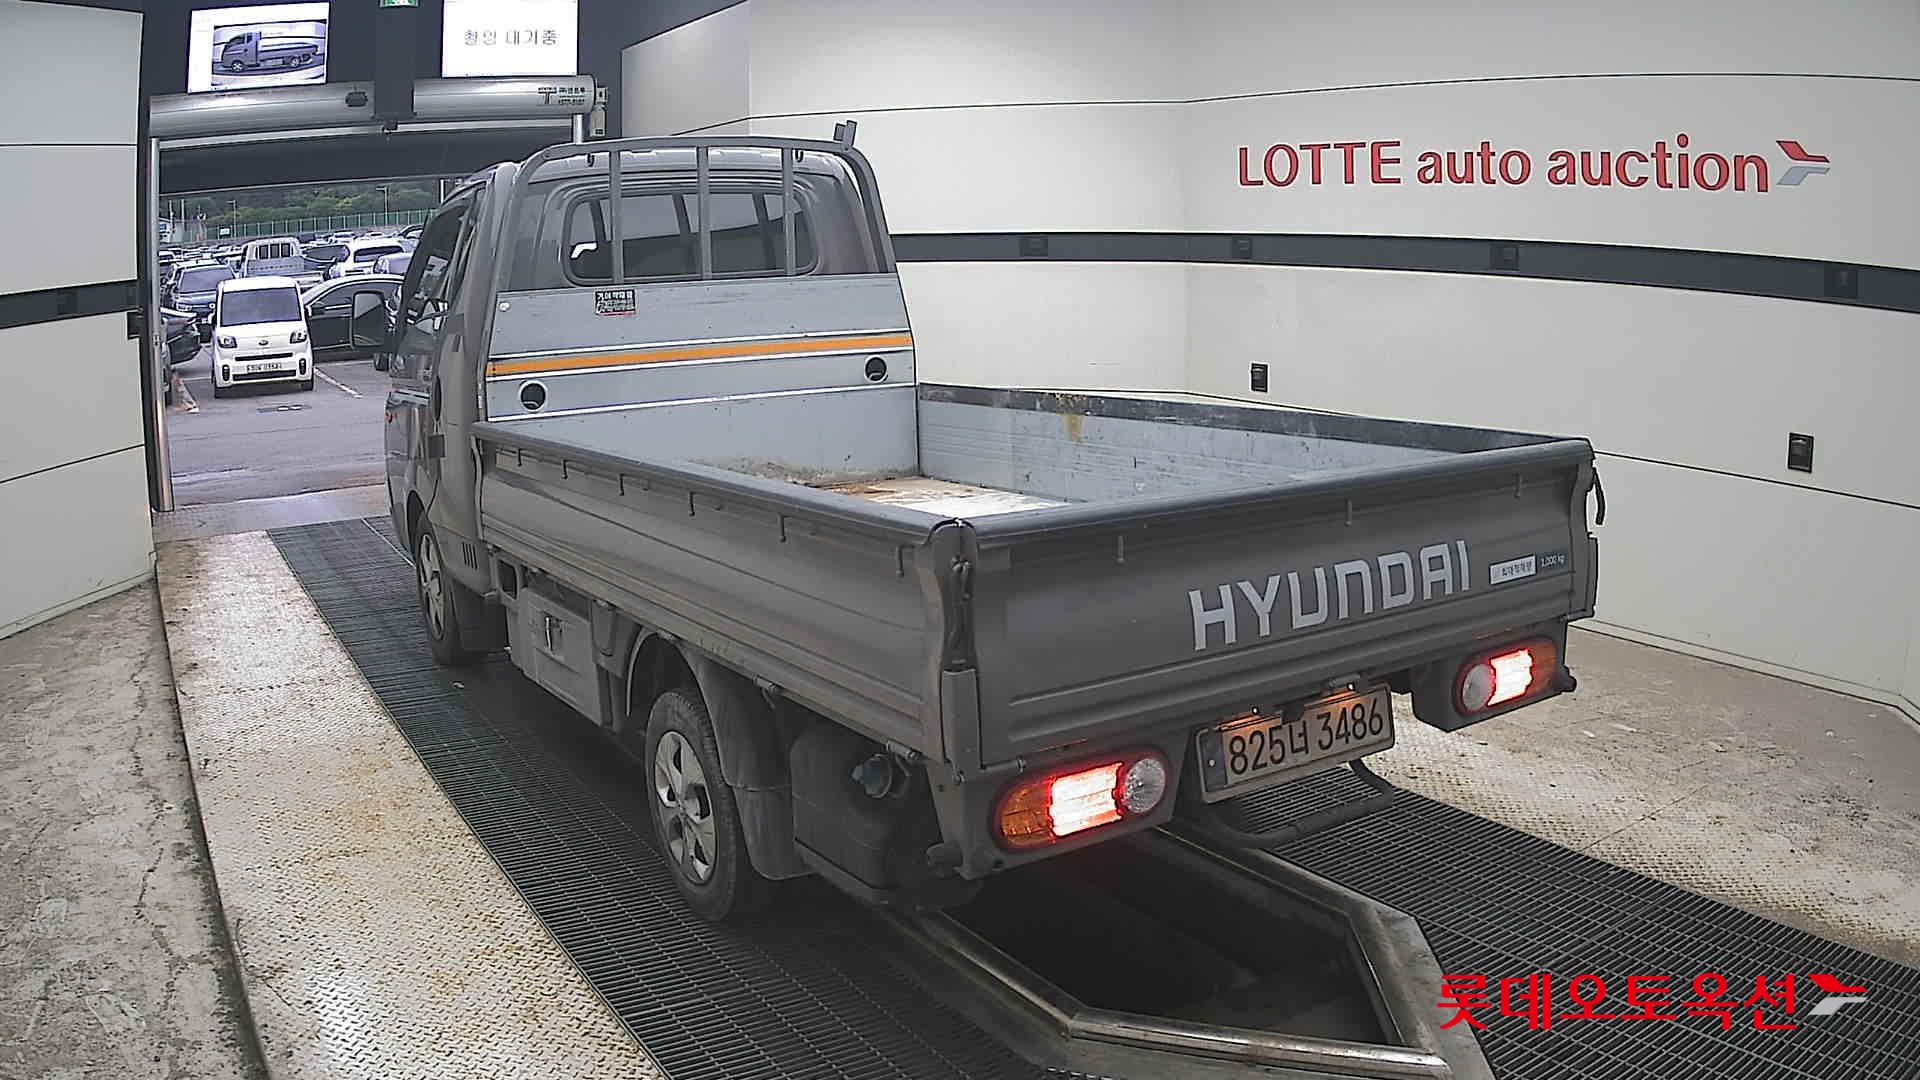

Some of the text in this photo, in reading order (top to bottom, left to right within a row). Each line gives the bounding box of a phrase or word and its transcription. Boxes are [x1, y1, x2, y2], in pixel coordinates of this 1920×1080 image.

[505, 29, 557, 46] 대기중
[1239, 134, 1769, 193] LOTTE auto auction
[1188, 540, 1472, 651] HYUNDAI
[1229, 697, 1384, 775] 825너 3486
